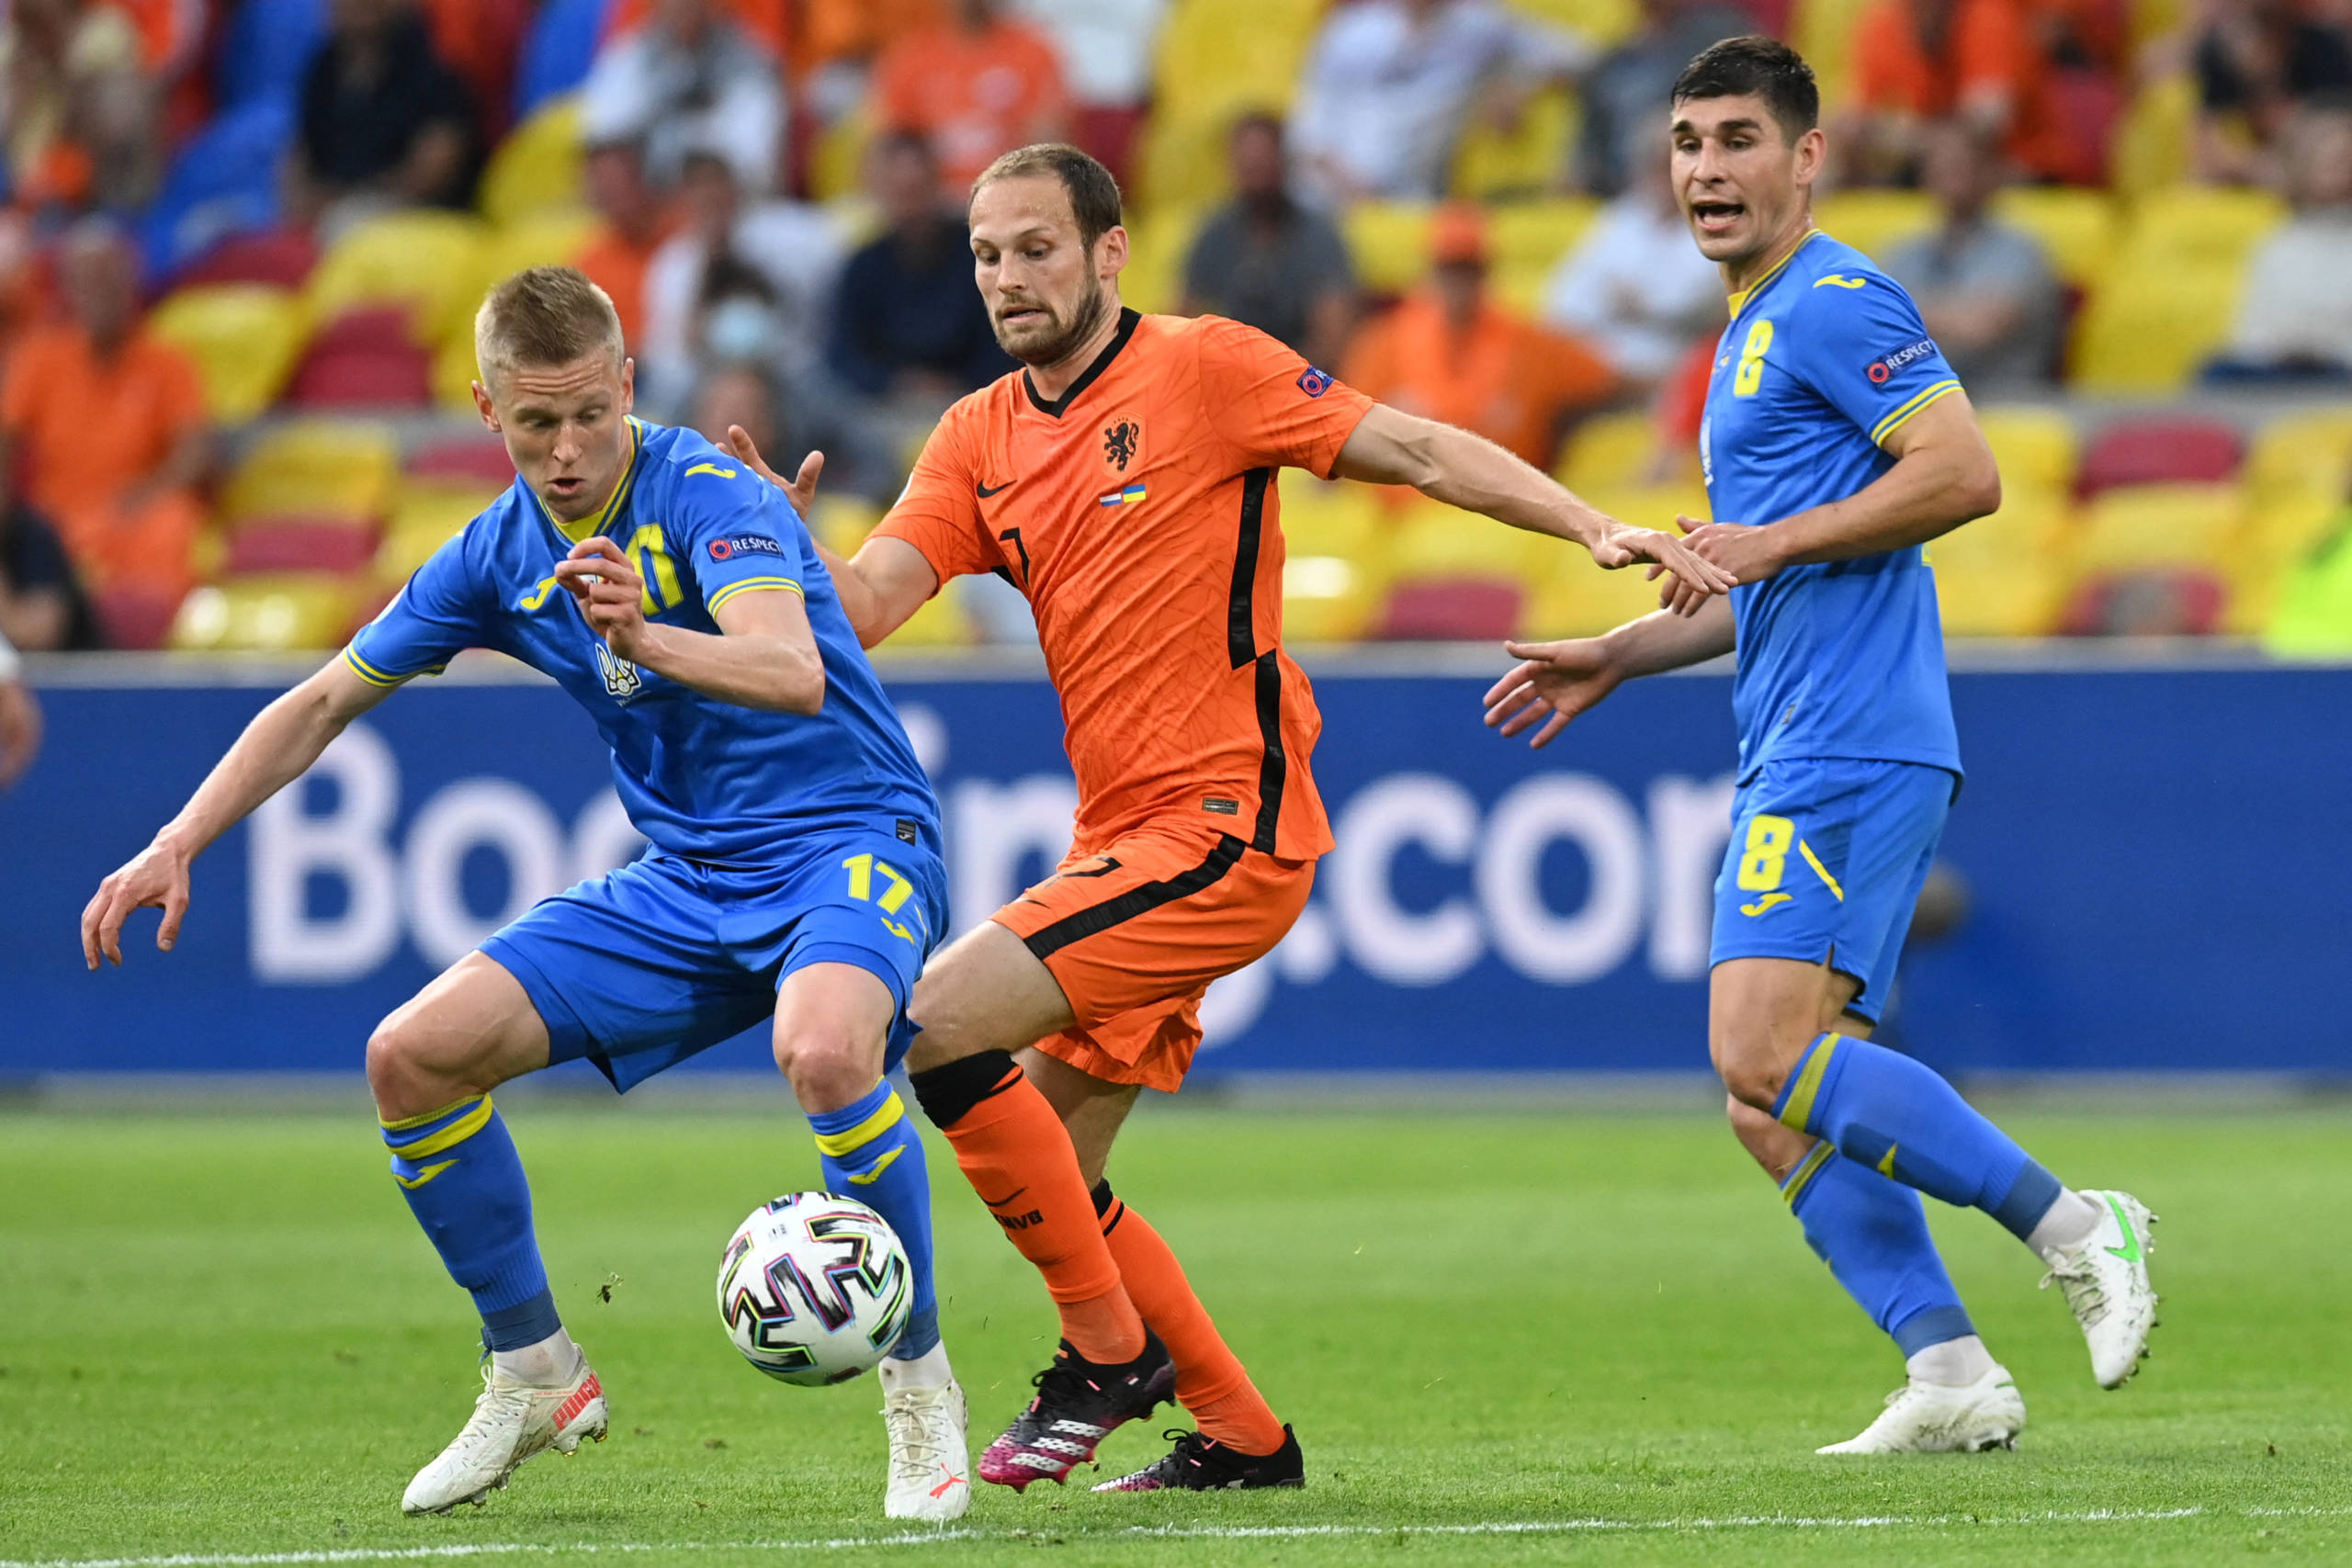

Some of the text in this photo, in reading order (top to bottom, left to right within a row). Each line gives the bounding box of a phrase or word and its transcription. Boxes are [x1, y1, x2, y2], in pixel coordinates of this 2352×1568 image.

[1734, 320, 1773, 397] 8
[1885, 341, 1933, 369] RESPECT
[999, 527, 1030, 585] 7
[246, 702, 1740, 1049] Bon.co
[842, 853, 914, 916] 17
[1736, 814, 1795, 891] 8
